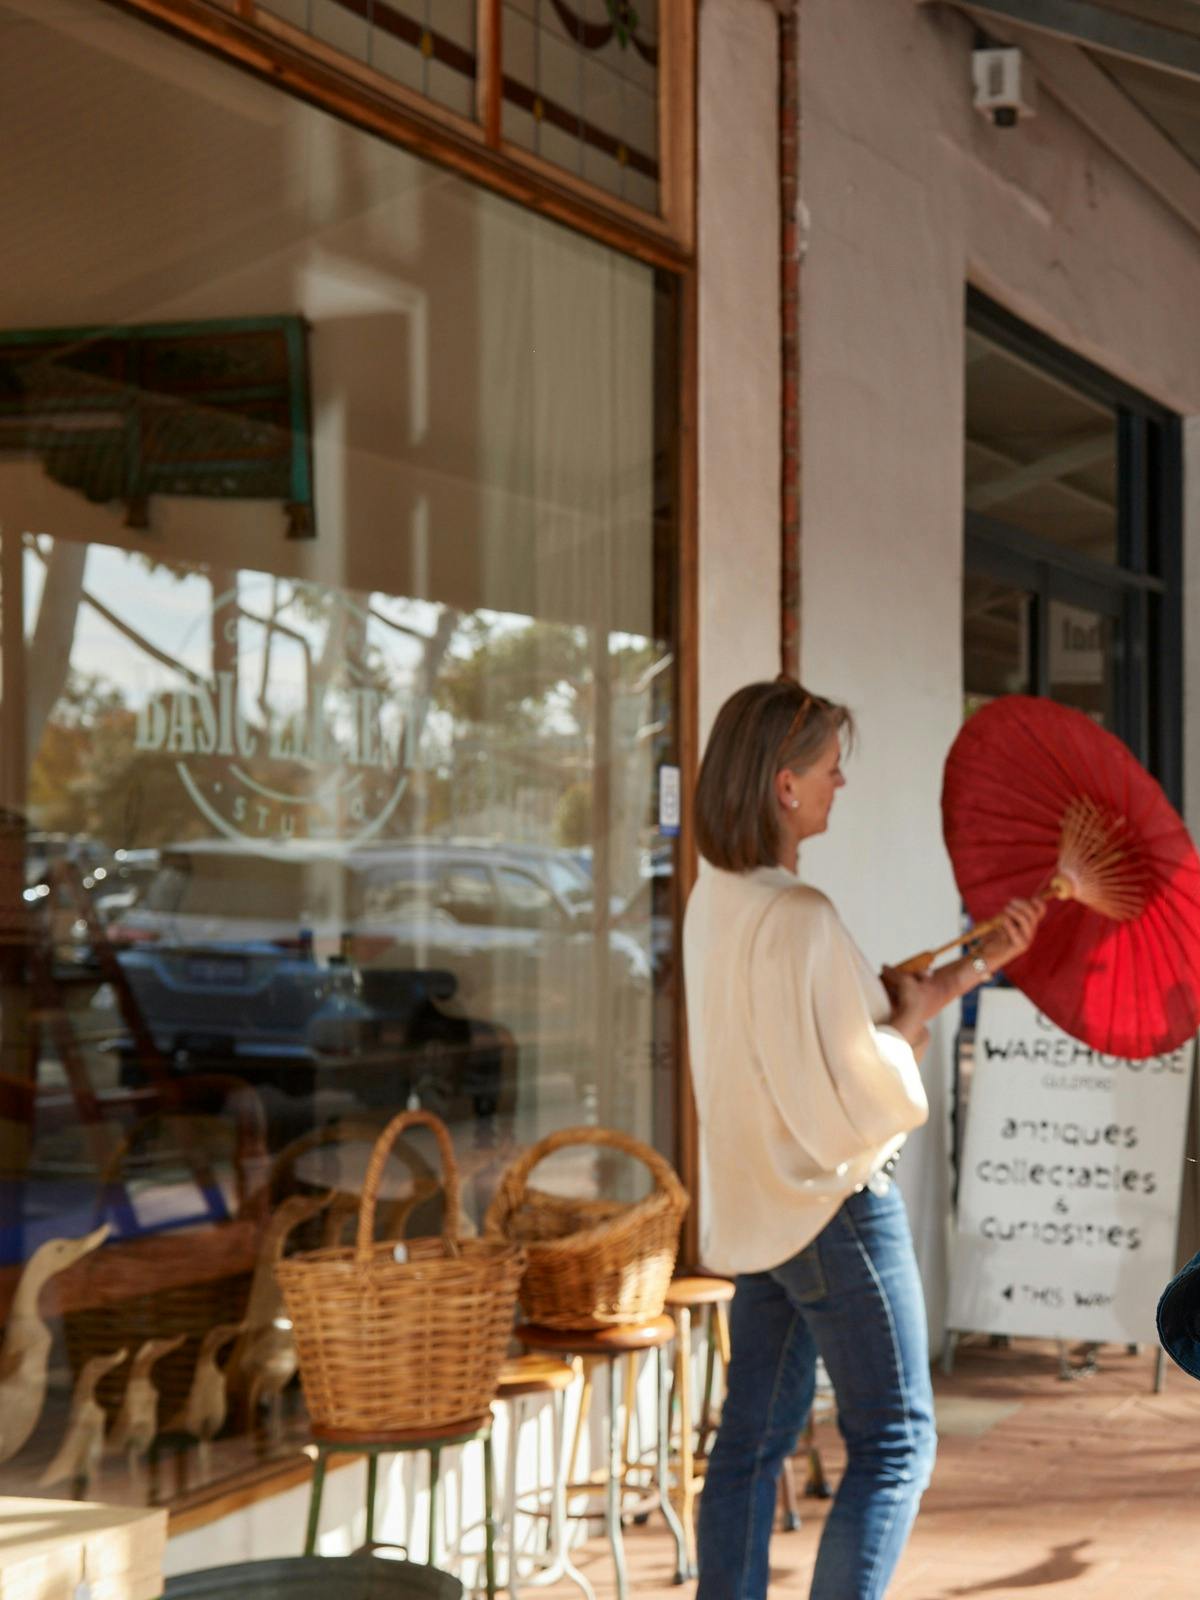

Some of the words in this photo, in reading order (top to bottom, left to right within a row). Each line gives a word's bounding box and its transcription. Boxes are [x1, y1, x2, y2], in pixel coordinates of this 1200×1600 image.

[232, 795, 366, 838] STUO
[1001, 1117, 1139, 1149] antiques
[975, 1159, 1158, 1195] collectables
[978, 1216, 1142, 1250] curiosities
